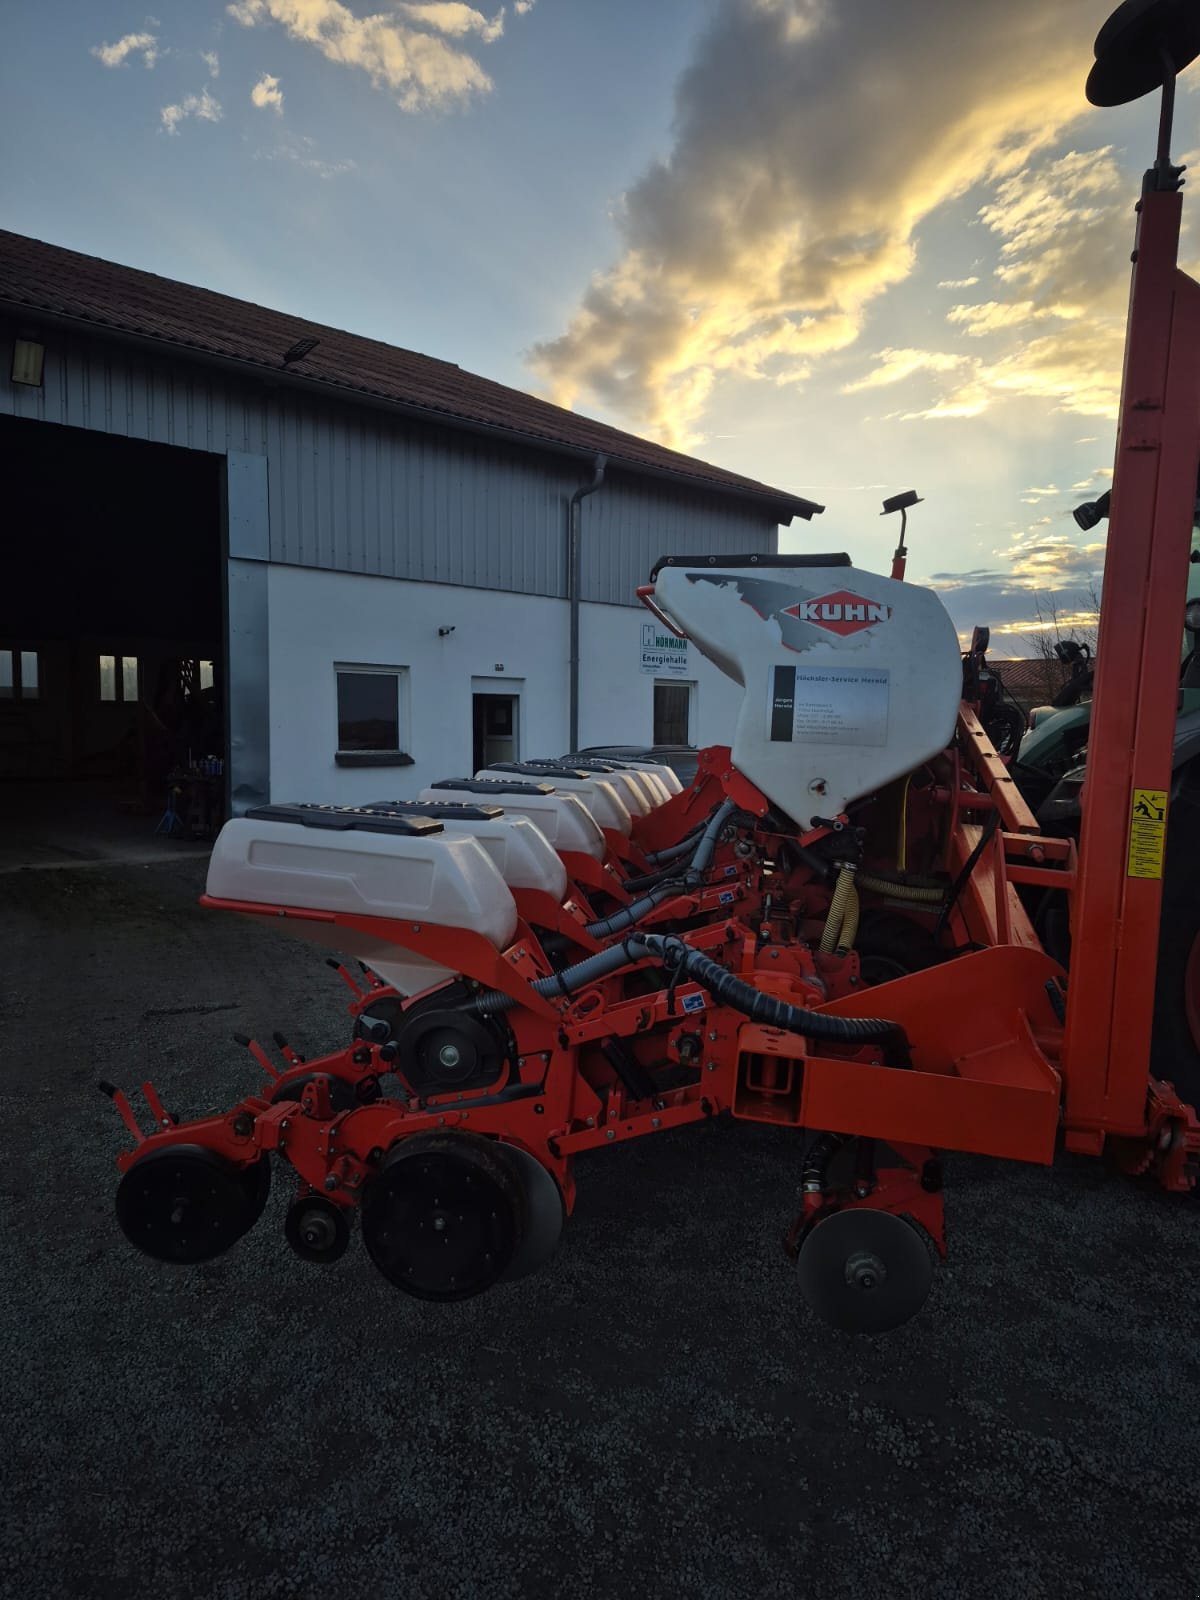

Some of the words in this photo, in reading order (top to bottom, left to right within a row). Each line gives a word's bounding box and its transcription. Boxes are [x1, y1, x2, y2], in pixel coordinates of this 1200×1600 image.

[799, 602, 889, 622] KUHN
[656, 635, 687, 650] HÖRMANN
[642, 654, 687, 664] Energiehalle
